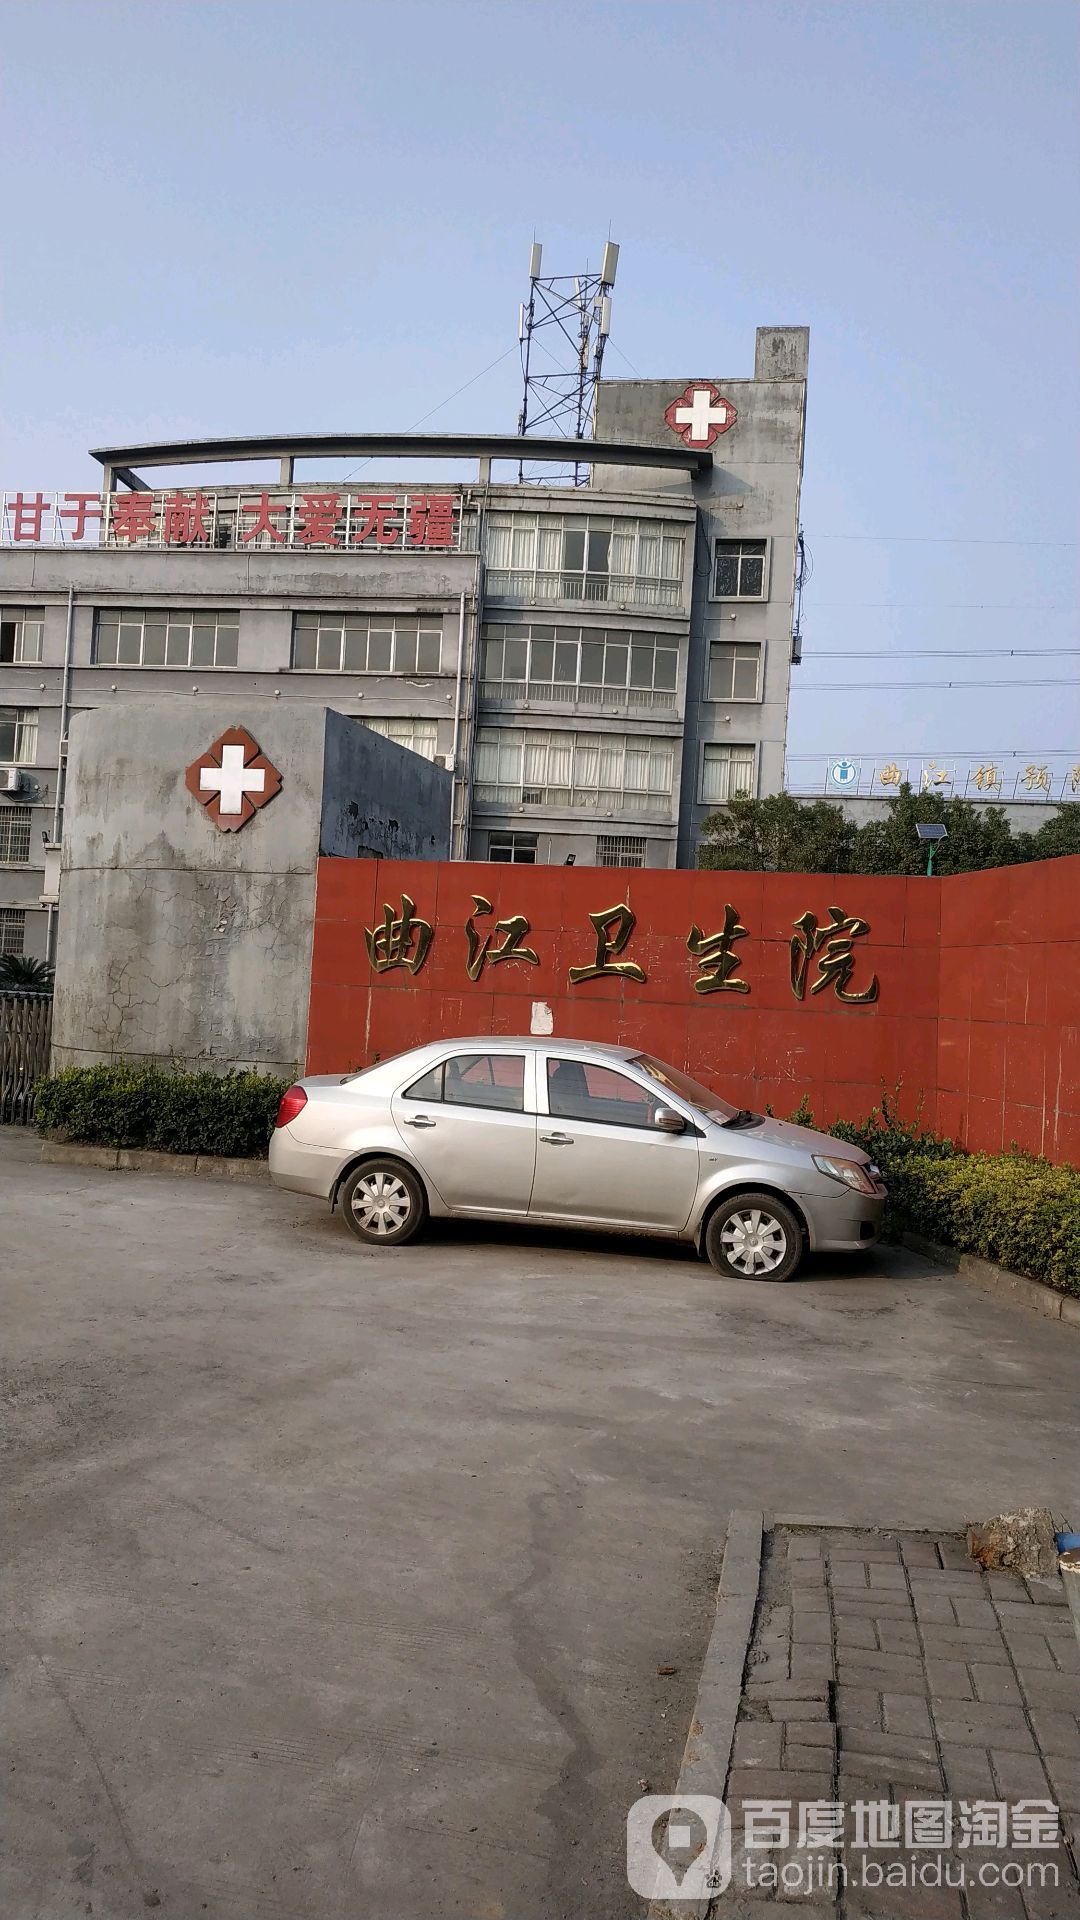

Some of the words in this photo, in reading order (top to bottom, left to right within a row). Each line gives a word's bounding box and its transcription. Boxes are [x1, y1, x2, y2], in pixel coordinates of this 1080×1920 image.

[8, 491, 210, 543] 甘于奉献
[241, 492, 458, 546] 大爱无疆
[363, 893, 879, 1003] 曲江卫生院
